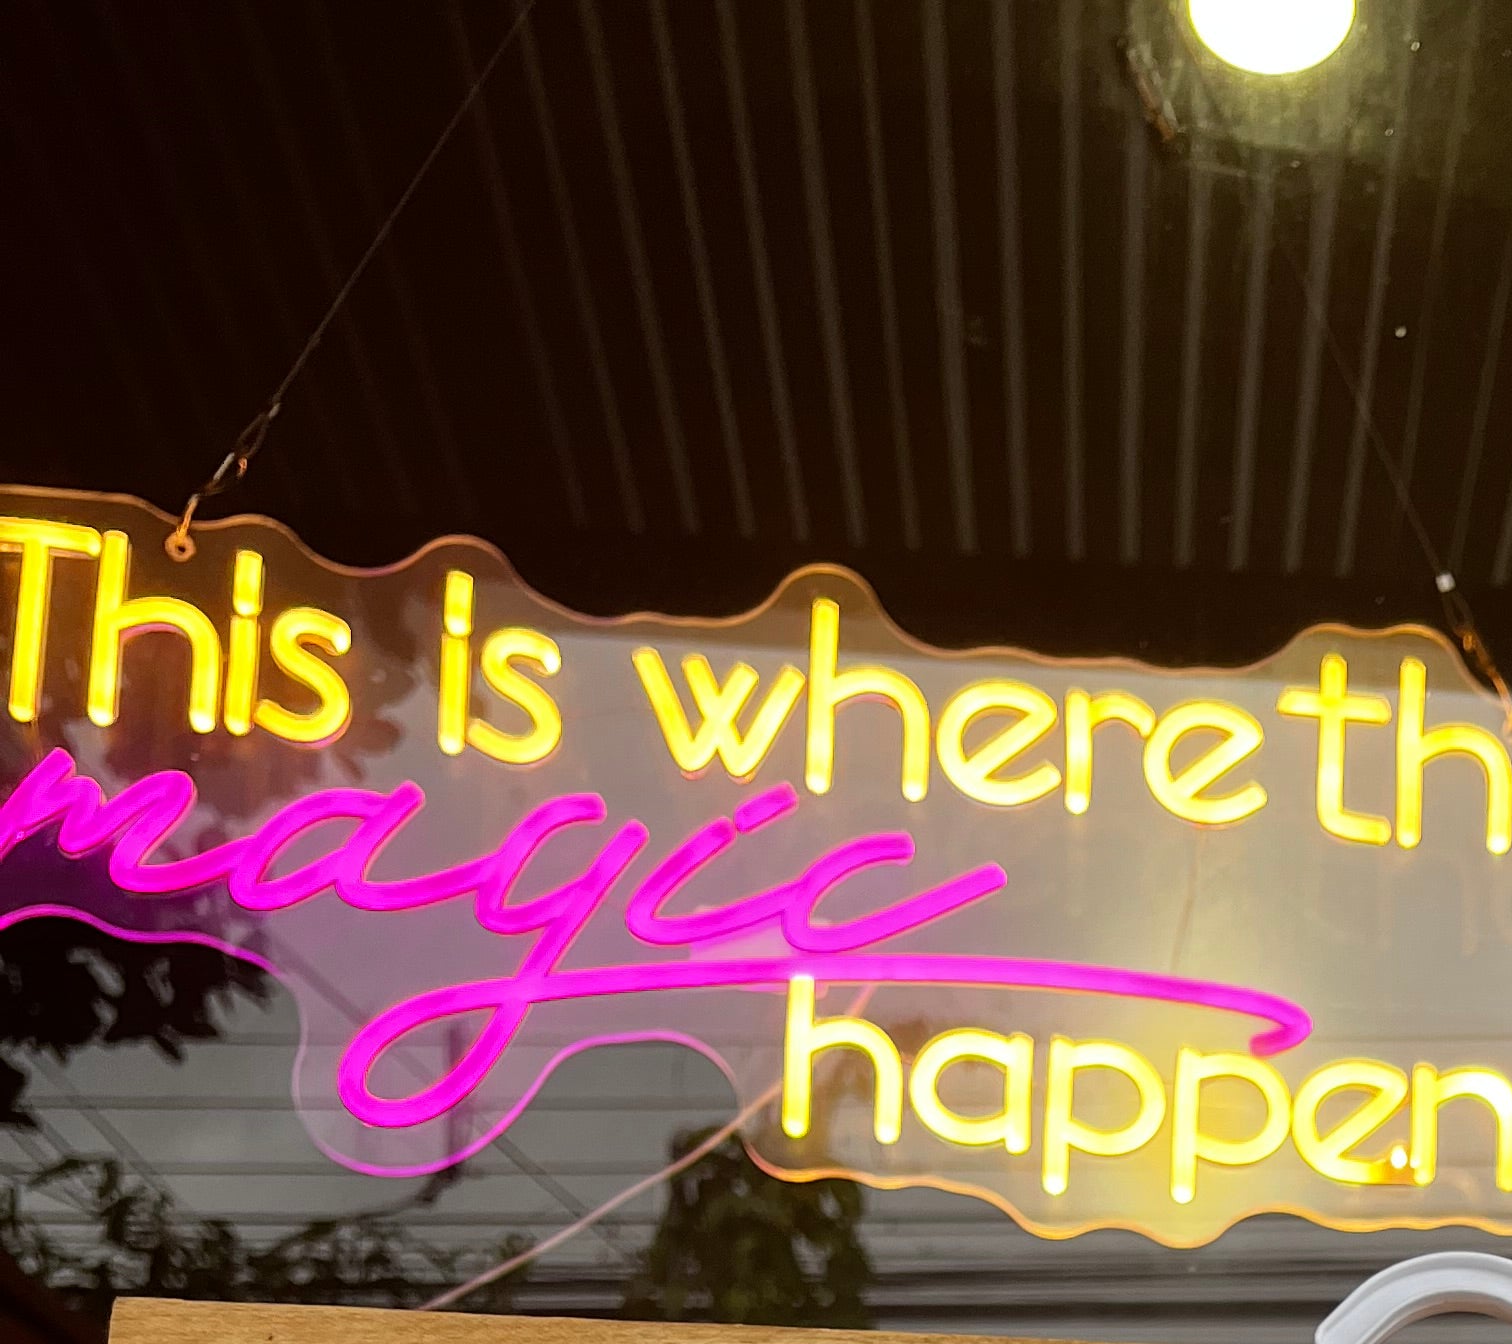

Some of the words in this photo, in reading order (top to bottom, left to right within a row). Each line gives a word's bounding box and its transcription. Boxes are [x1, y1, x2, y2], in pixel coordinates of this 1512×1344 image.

[0, 516, 352, 744] This
[439, 570, 562, 764] is
[632, 598, 1268, 825] where
[0, 746, 1312, 1128] magic
